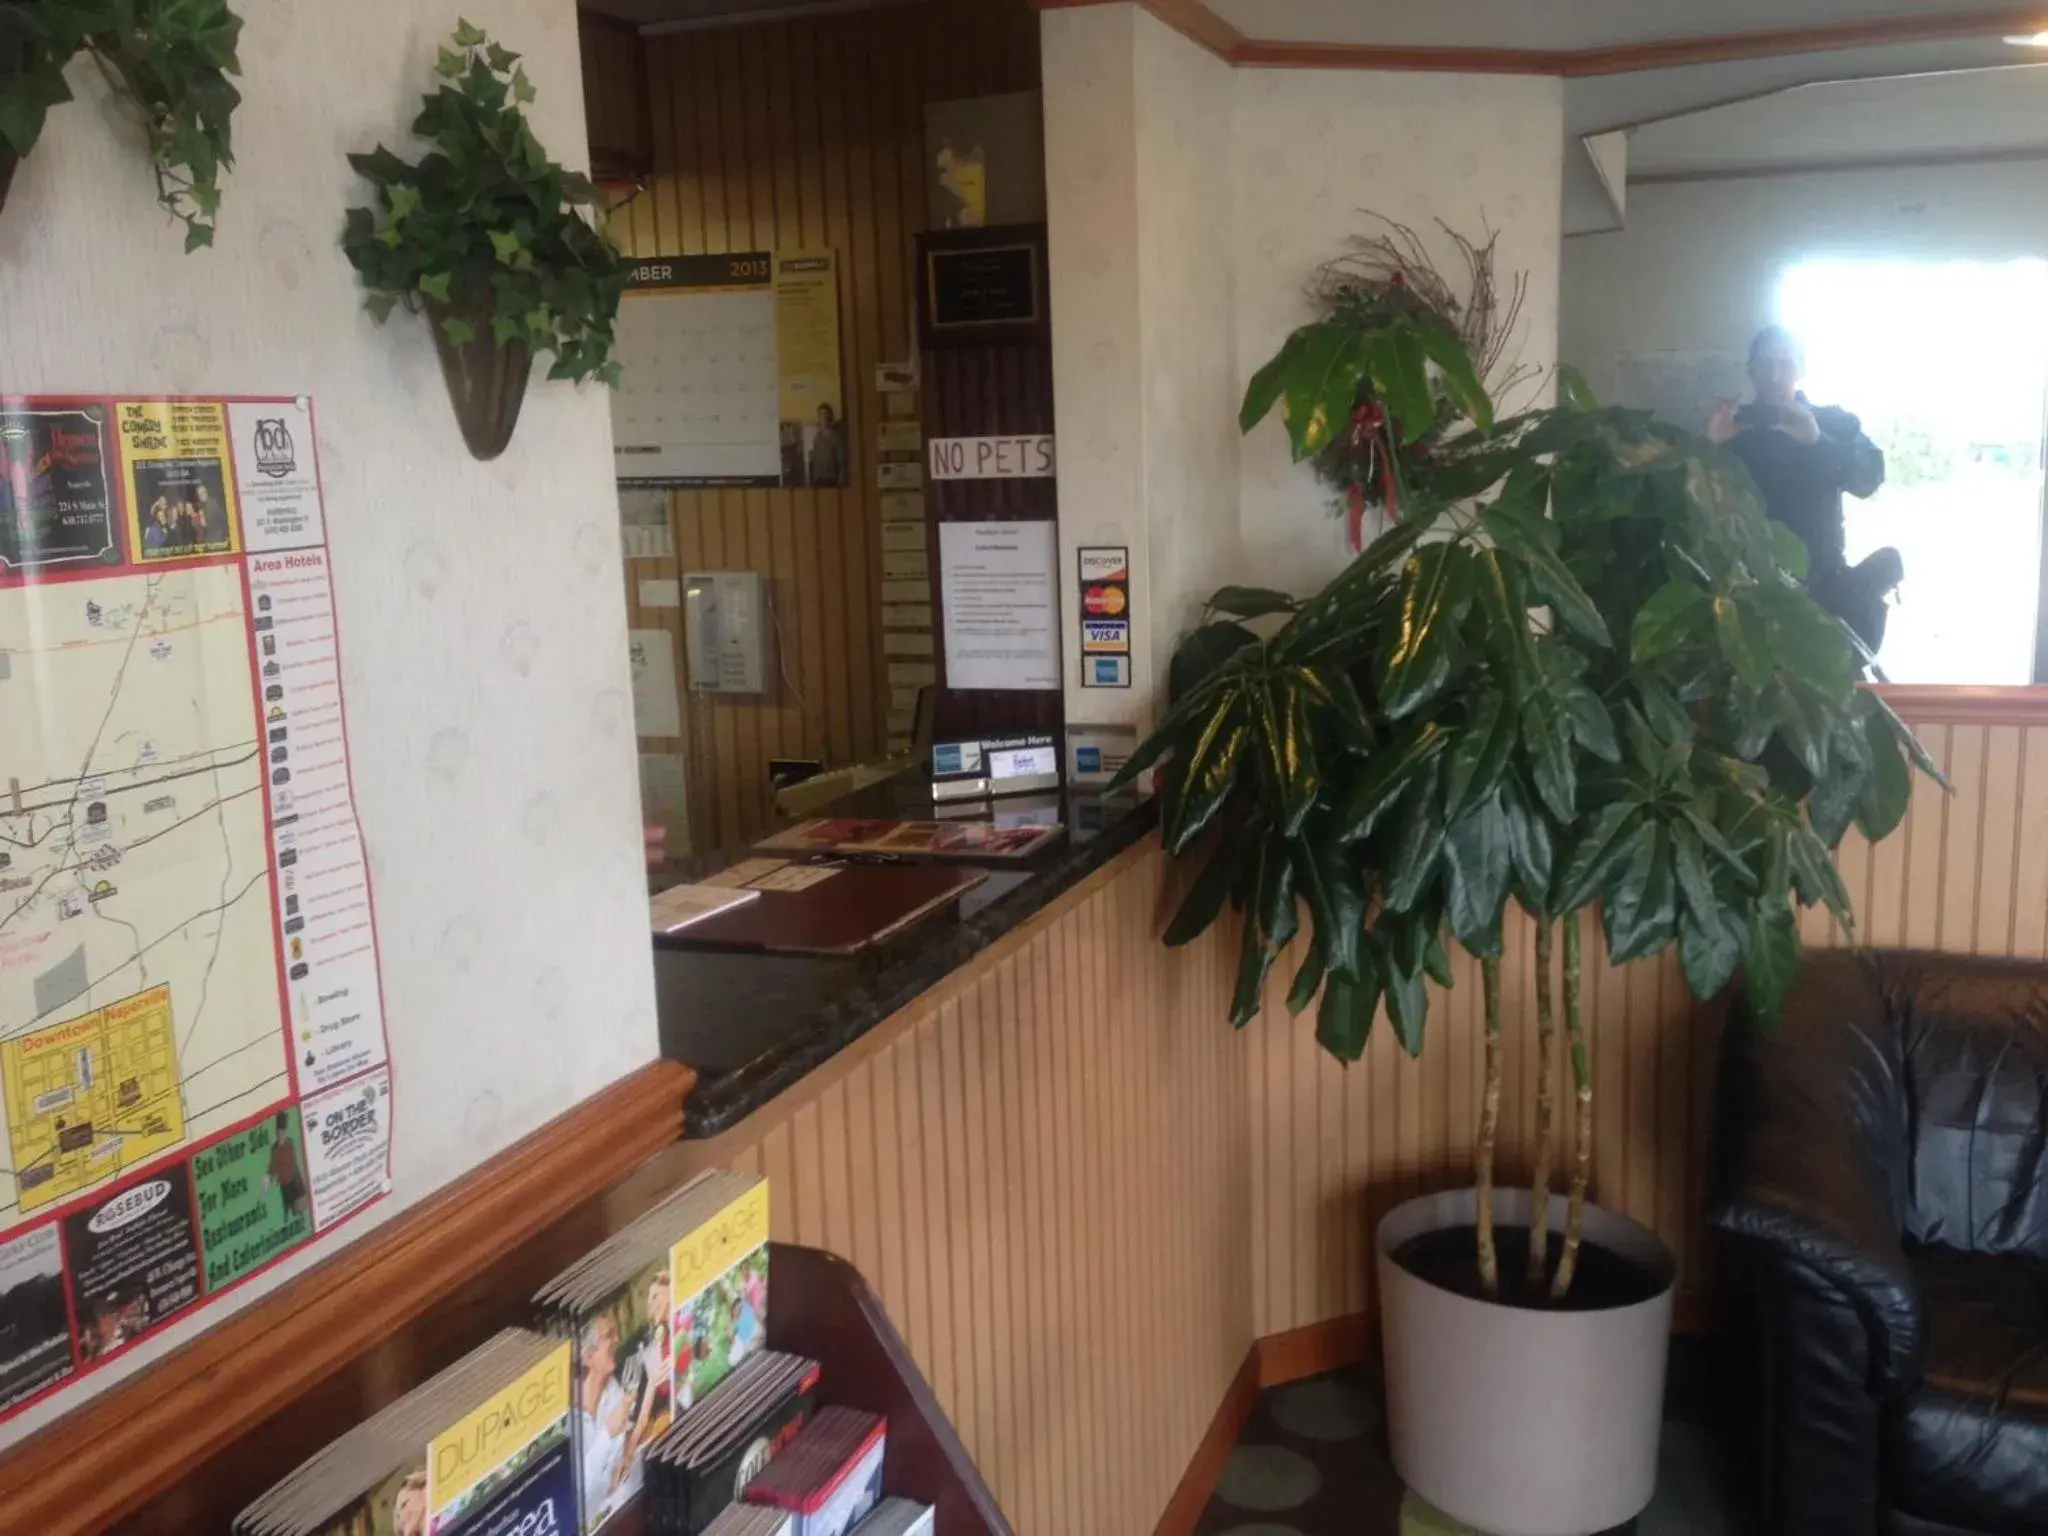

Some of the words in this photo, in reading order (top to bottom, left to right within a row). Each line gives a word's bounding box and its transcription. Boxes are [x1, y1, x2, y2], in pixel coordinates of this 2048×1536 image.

[730, 260, 769, 277] 2013
[122, 419, 161, 433] COMEDY
[126, 406, 143, 418] THE
[935, 442, 964, 474] NO
[977, 439, 1053, 474] PETS
[253, 559, 282, 572] Area
[285, 555, 322, 569] Hotels
[1090, 630, 1120, 641] VISA
[981, 738, 1026, 750] Welcome
[1027, 736, 1053, 745] Here
[22, 1016, 100, 1052] Downtown
[321, 1109, 378, 1144] BORDER
[326, 1109, 344, 1126] ON
[345, 1100, 368, 1117] THE
[195, 1157, 214, 1180] See
[216, 1141, 245, 1170] Other
[248, 1126, 269, 1153] Side
[96, 1182, 166, 1227] ROSEBUD
[199, 1190, 217, 1220] For
[221, 1176, 248, 1209] More
[203, 1200, 268, 1251] Restaurants
[677, 1195, 762, 1284] DUPAGE
[208, 1253, 231, 1291] And
[232, 1213, 305, 1272] Entertainment
